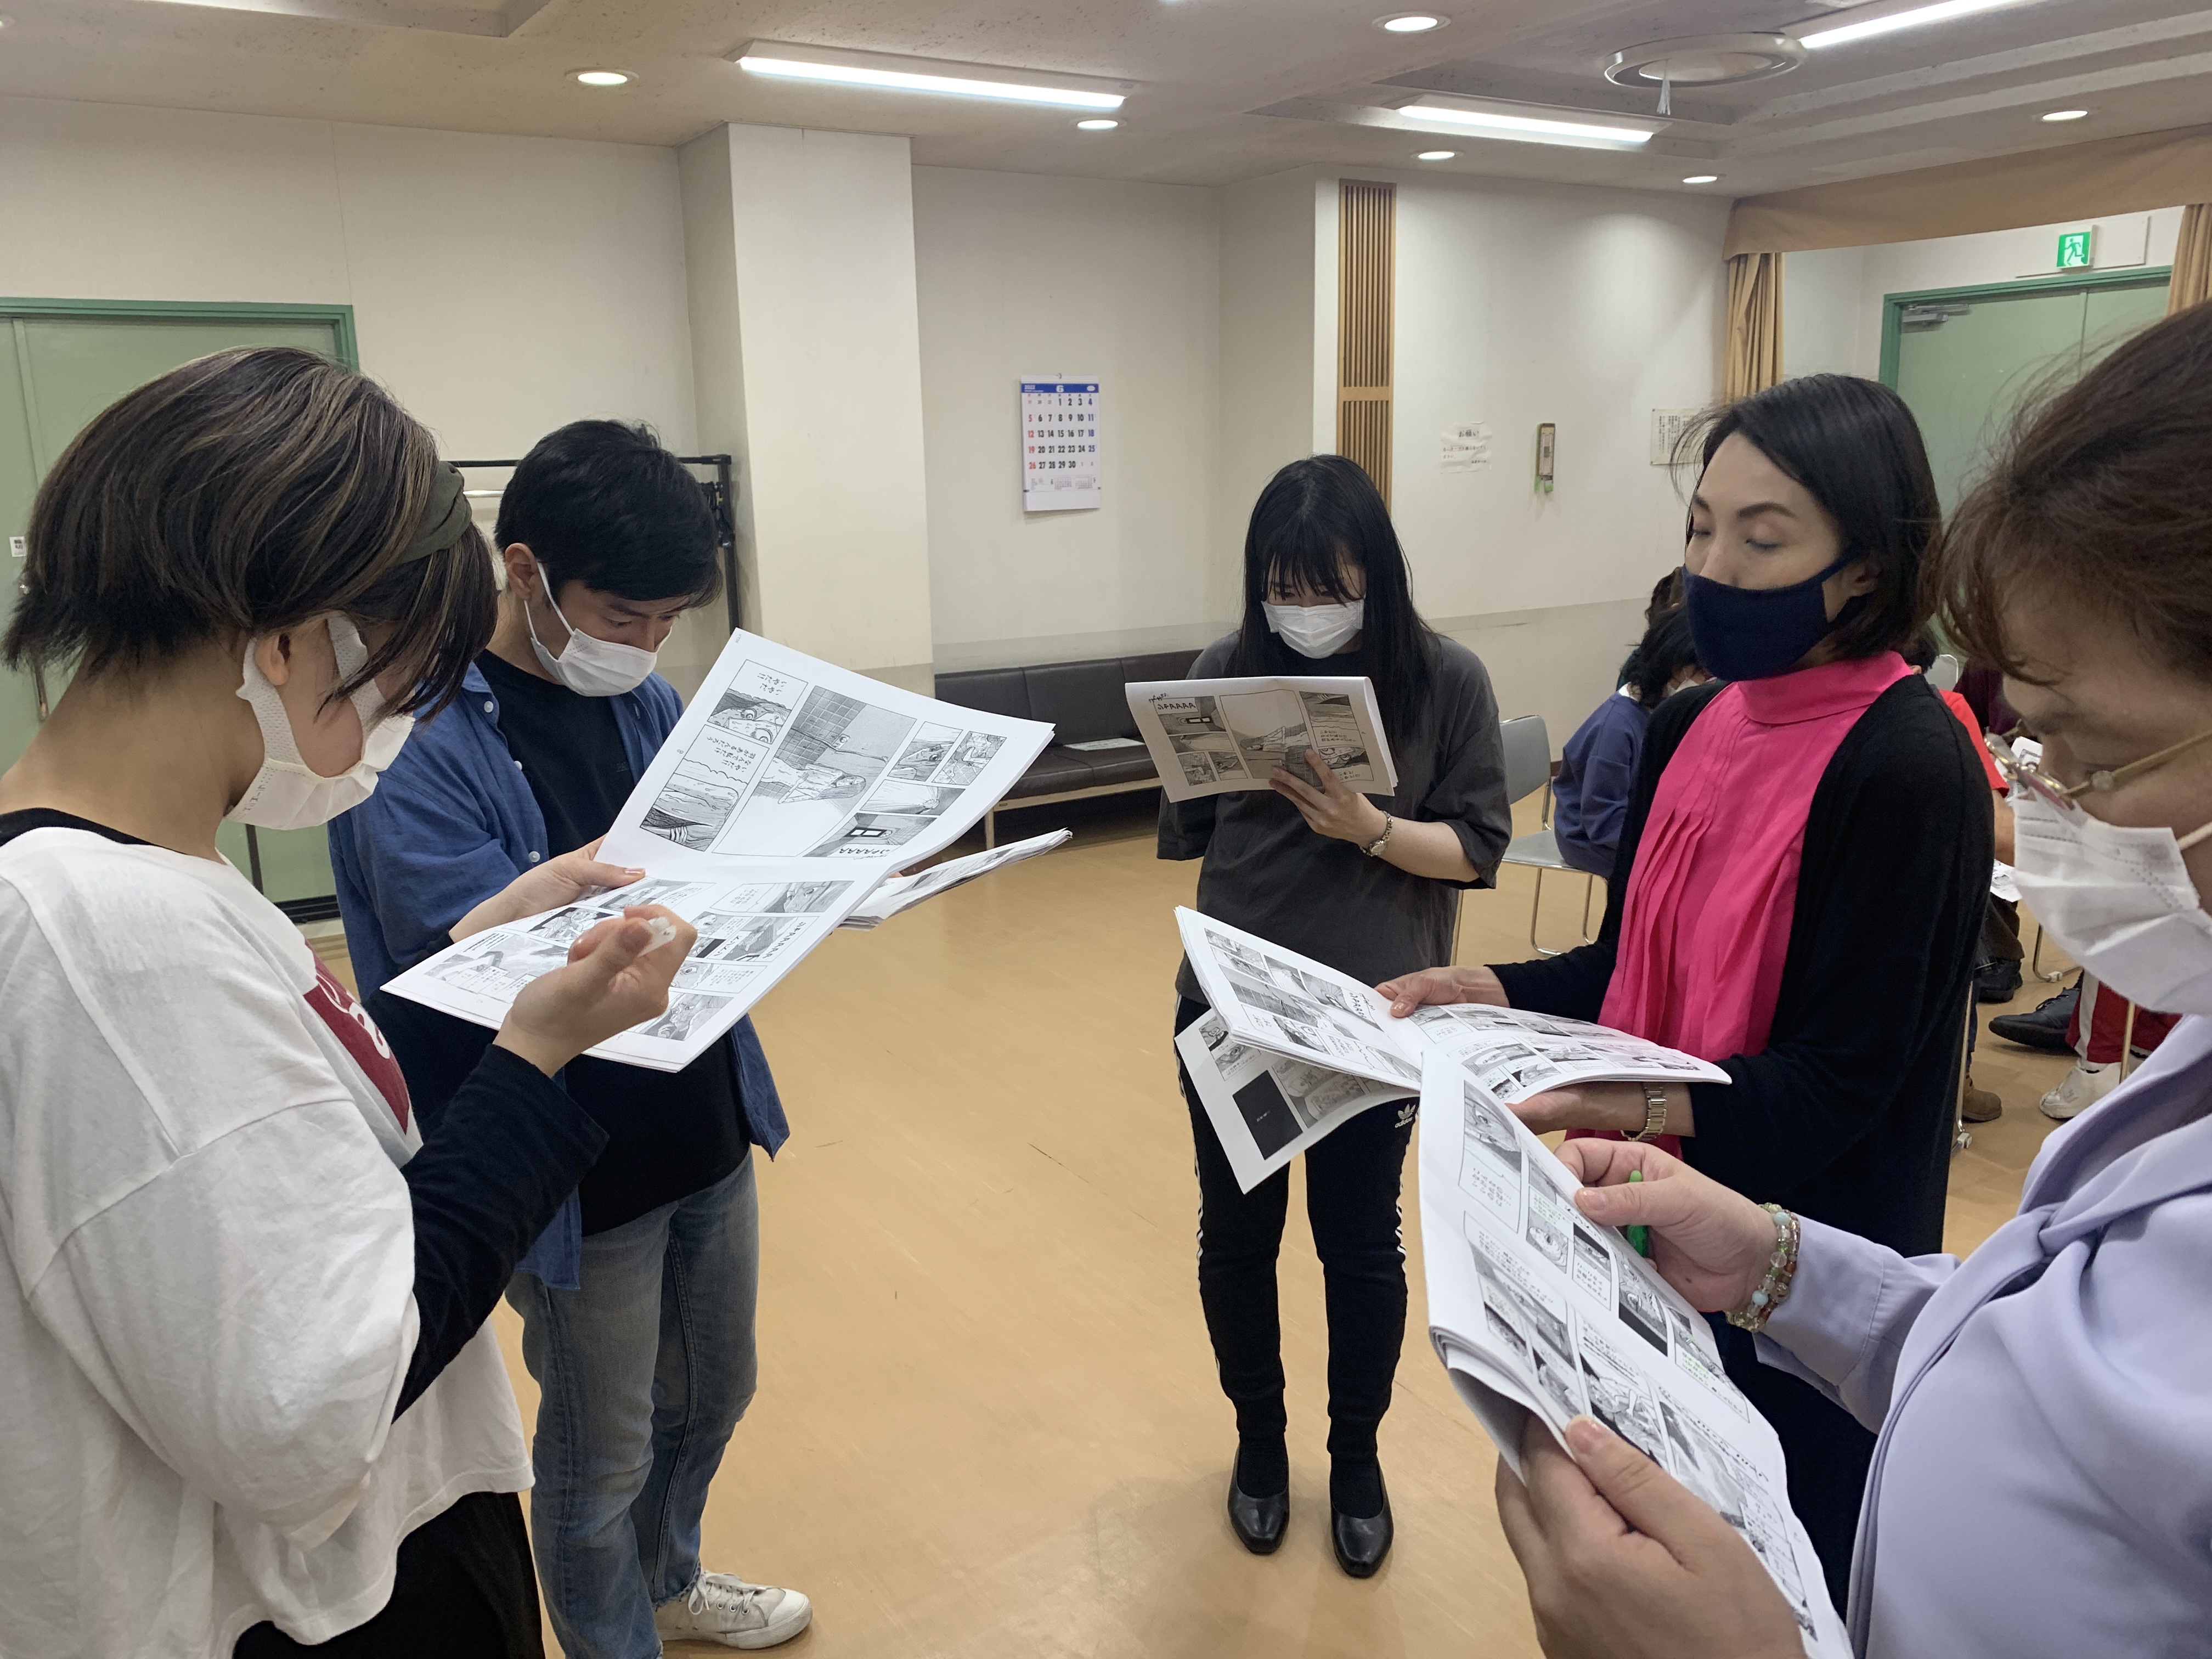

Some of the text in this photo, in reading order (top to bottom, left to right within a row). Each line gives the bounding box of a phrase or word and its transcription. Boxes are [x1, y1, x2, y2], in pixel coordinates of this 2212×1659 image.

[1459, 429, 1479, 437] お願い
[759, 682, 782, 695] いやだ
[714, 747, 752, 766] なんで私だけ
[1395, 1116, 1413, 1128] adidas
